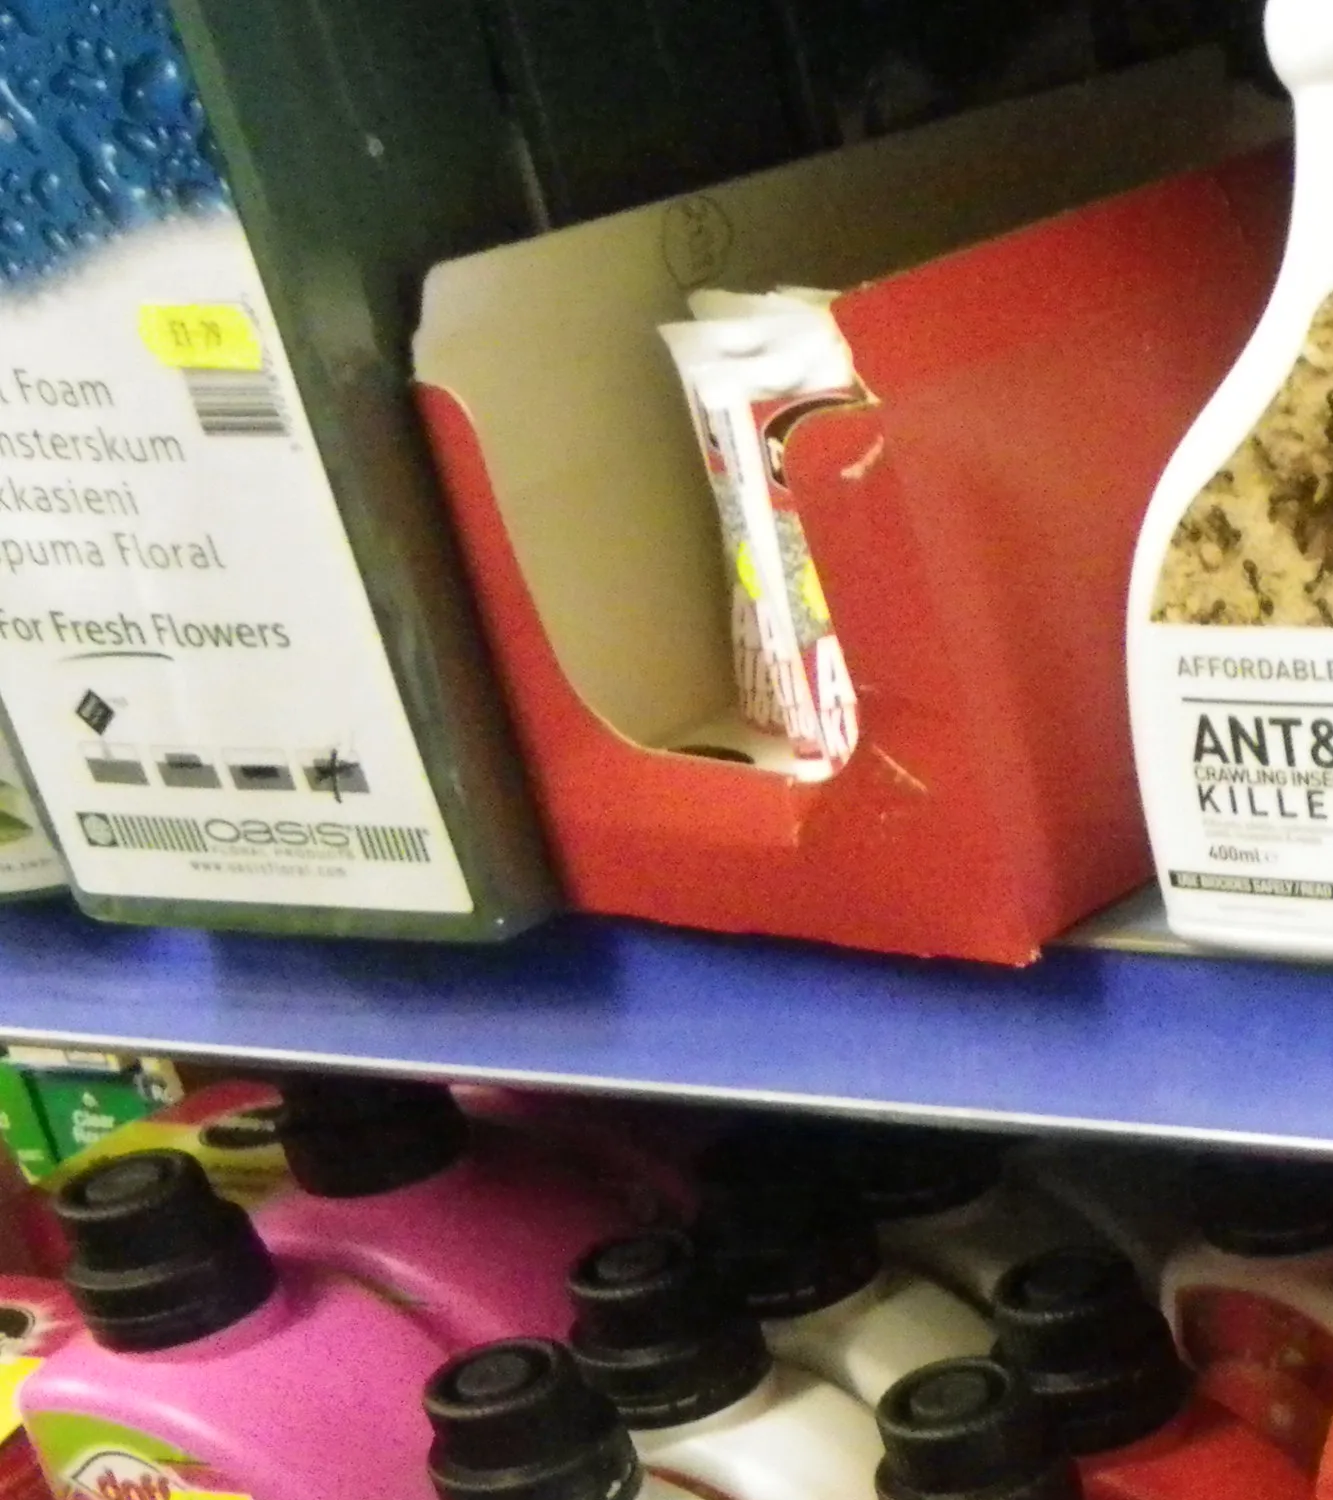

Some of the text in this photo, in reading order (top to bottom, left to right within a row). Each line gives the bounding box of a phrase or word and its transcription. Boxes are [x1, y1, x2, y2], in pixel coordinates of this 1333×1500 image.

[13, 367, 114, 408] Foam
[112, 531, 228, 570] Floral
[48, 609, 148, 647] Fresh
[150, 613, 291, 650] Flowers
[1194, 765, 1287, 787] CRAWLING
[1209, 844, 1260, 863] 400ml
